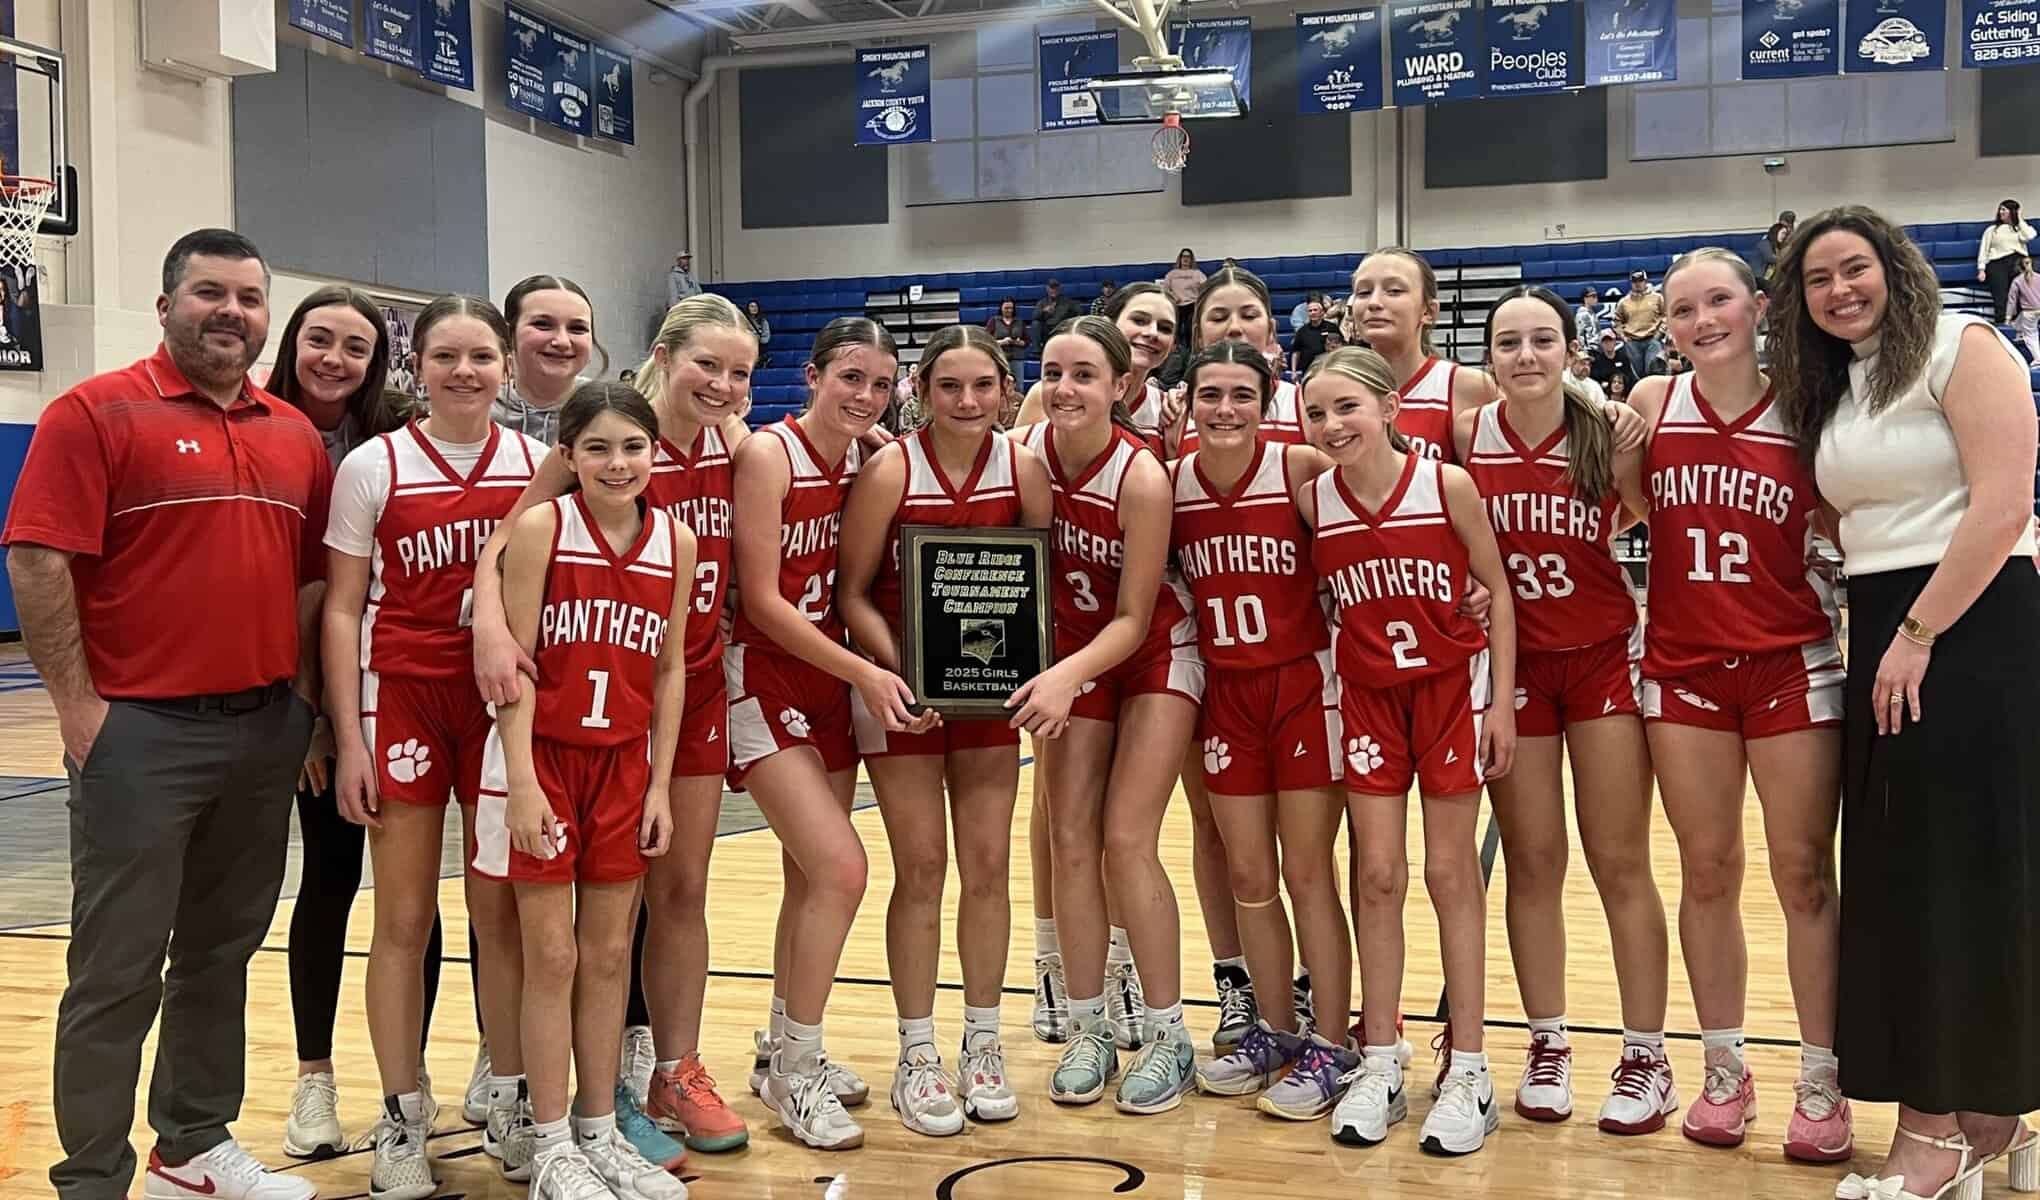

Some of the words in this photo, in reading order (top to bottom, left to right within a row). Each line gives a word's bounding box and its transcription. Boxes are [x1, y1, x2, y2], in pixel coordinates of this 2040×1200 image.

[1976, 13, 1993, 25] AC
[1998, 9, 2037, 24] Siding
[1405, 52, 1463, 77] WARD
[1491, 49, 1567, 72] Peoples
[1750, 48, 1789, 60] current
[1974, 45, 2040, 61] 828-631-33
[1397, 74, 1434, 88] PLUMBING
[1443, 70, 1475, 81] HEATING
[1536, 67, 1567, 79] Clubs
[0, 350, 31, 365] IOR
[1652, 464, 1794, 524] PANTHERS
[668, 497, 733, 539] THER
[1482, 493, 1601, 542] NTHERS
[397, 519, 503, 577] PANTH
[781, 512, 840, 559] PANTH
[1053, 517, 1123, 568] THERS
[936, 550, 975, 566] BLUE
[978, 551, 1023, 567] RIDGE
[1686, 528, 1752, 583] 12
[931, 582, 1030, 599] TOURNAMENT
[934, 566, 1026, 583] CONFERENCE
[1507, 553, 1575, 600] 33
[943, 599, 1018, 615] CHAMPION
[1066, 571, 1099, 611] 3
[542, 599, 668, 658] PANTHERS
[1207, 595, 1268, 646] 10
[1386, 621, 1428, 669] 2
[945, 667, 980, 678] 2025
[982, 668, 1019, 678] GIRLS
[581, 669, 611, 728] 1
